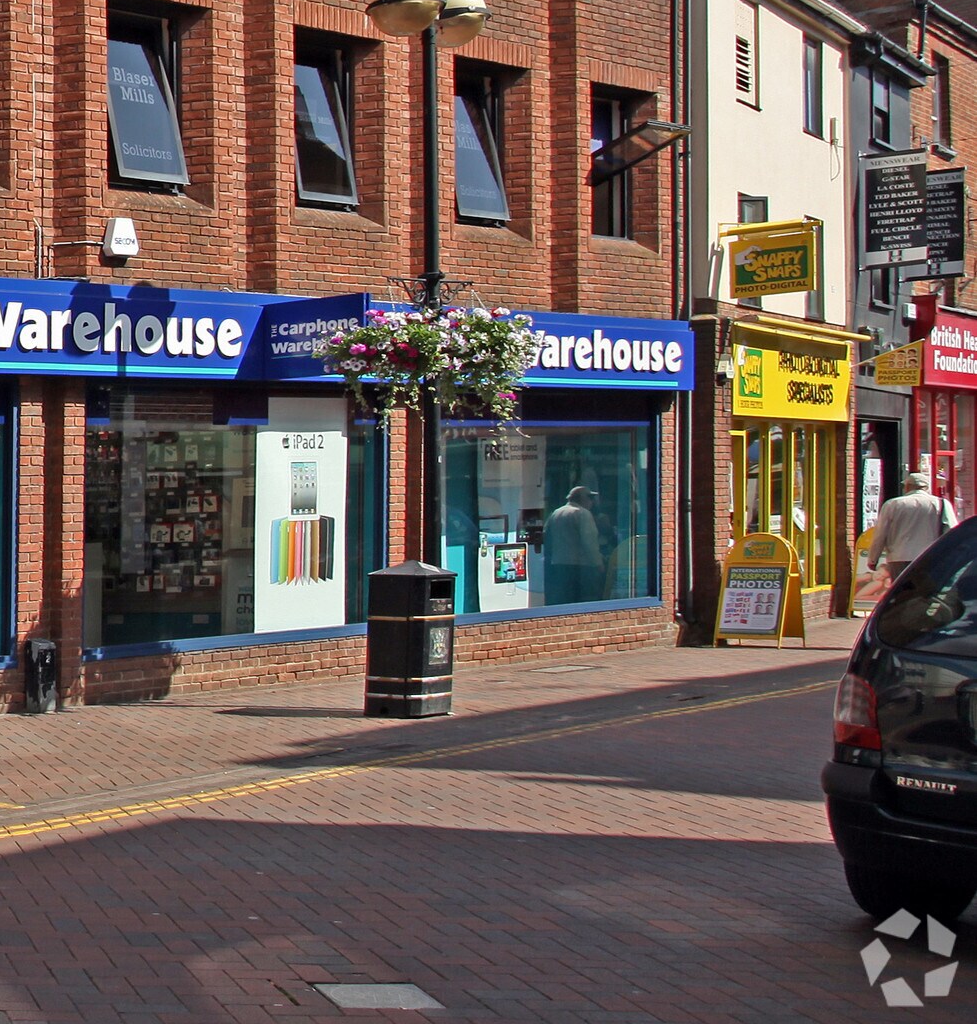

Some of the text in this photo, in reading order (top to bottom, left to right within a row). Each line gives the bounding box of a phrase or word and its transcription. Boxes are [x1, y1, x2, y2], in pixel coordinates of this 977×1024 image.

[112, 67, 155, 87] Blaser
[120, 86, 155, 105] Mills
[122, 142, 173, 161] Solicitors
[891, 190, 919, 198] BAKER
[898, 198, 924, 206] SCOTT
[896, 207, 923, 215] LLOYD
[877, 217, 916, 225] FIRETRAP
[892, 224, 922, 233] CIRCLE
[883, 234, 910, 242] BENCH
[744, 250, 804, 272] SNAPPY
[753, 265, 801, 282] SNAPS
[278, 317, 359, 336] Carphone
[931, 325, 962, 349] British
[271, 338, 324, 354] Wareh
[293, 434, 324, 450] iPad 2
[729, 580, 781, 589] PHOTOS
[897, 775, 958, 793] RENAULT
